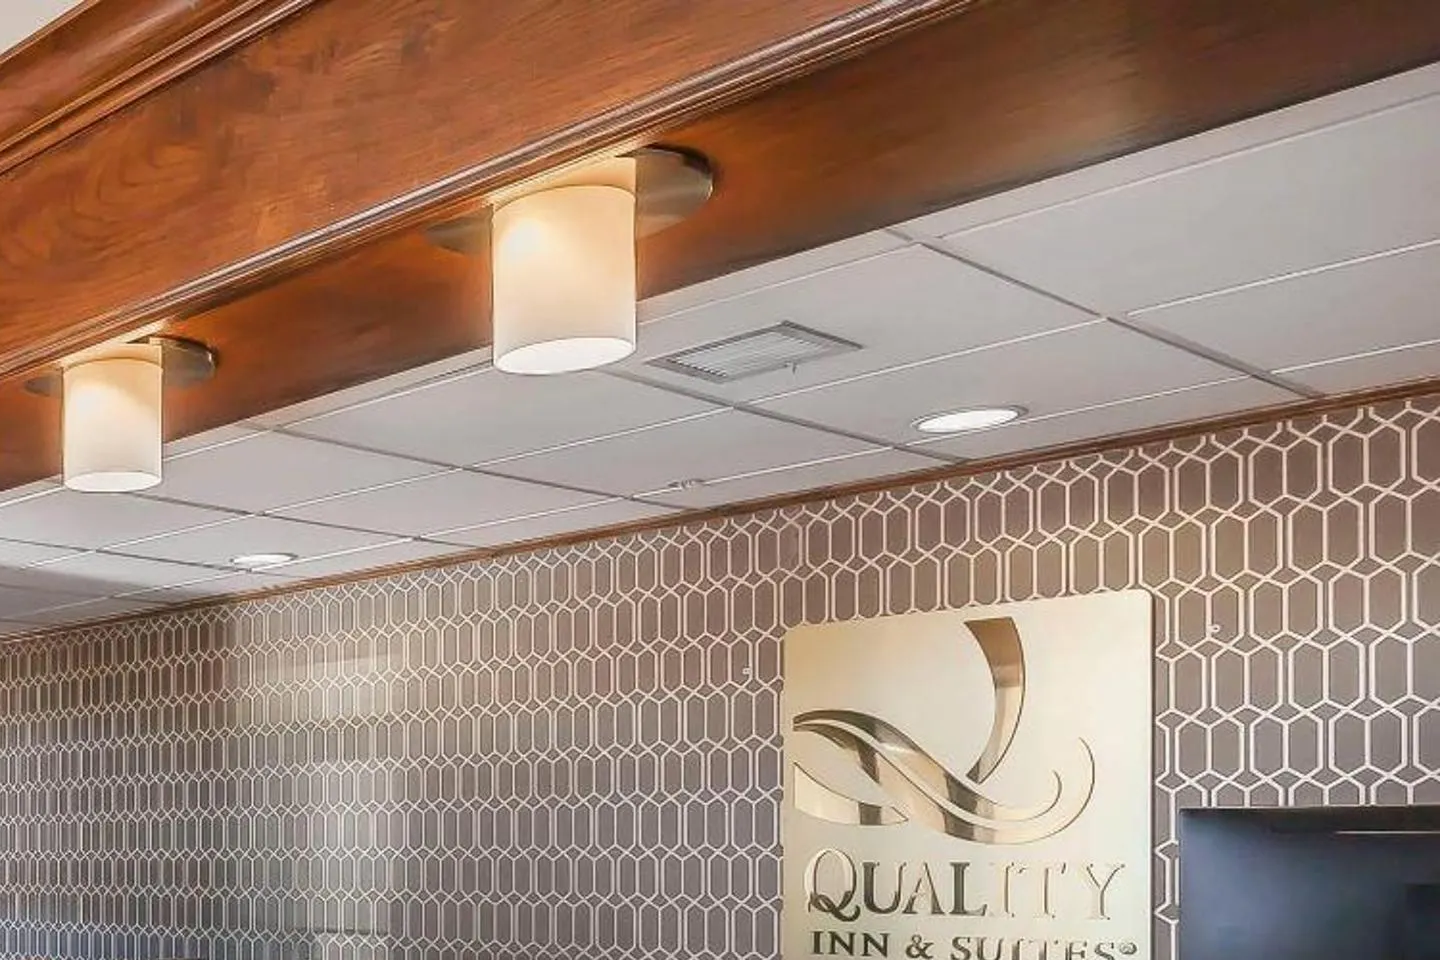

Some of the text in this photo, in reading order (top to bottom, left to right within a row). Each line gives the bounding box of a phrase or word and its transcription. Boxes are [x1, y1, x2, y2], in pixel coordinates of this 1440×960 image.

[804, 848, 1127, 922] QUALITY
[810, 930, 890, 958] INN
[905, 934, 934, 960] &
